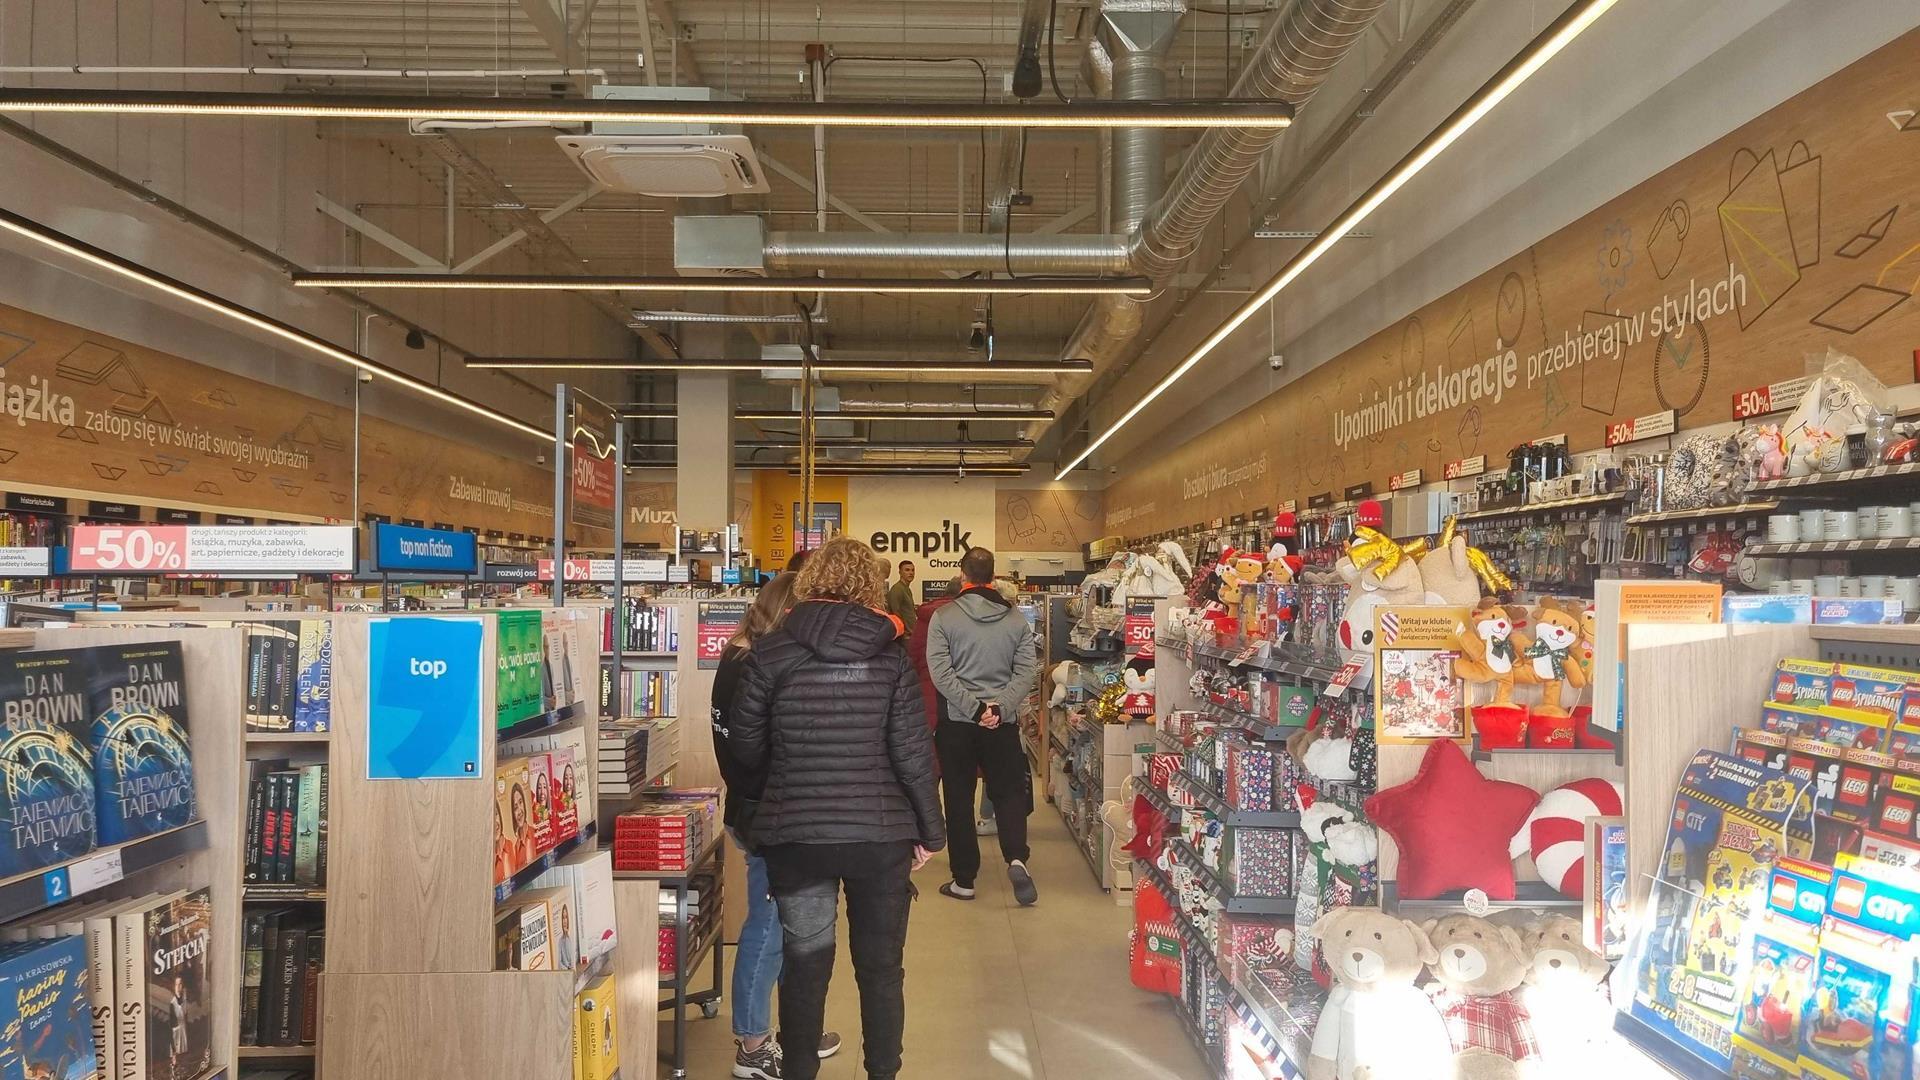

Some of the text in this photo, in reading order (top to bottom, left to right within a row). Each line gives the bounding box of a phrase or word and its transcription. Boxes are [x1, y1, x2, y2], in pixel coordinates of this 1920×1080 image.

[1527, 262, 1746, 389] przebieraj w stylach
[1334, 338, 1518, 452] Upominki i dekoracje
[1736, 391, 1770, 417] -50%
[84, 409, 131, 441] zatop
[134, 414, 156, 447] się
[159, 425, 172, 444] w
[174, 422, 211, 452] świat
[213, 435, 253, 464] swojej
[254, 444, 309, 470] wyobraźni
[1608, 423, 1633, 444] -50%
[574, 457, 596, 490] -50%
[449, 475, 482, 503] Zabawa
[486, 487, 511, 513] rozwój
[191, 538, 306, 548] książka, muzyka, zabawka,
[213, 528, 238, 537] tańszy
[238, 528, 268, 536] produkt
[870, 519, 972, 558] empik
[78, 528, 182, 570] -50%
[206, 548, 261, 558] papiernicze,
[261, 548, 296, 558] gadżety
[302, 548, 345, 558] dekoracje
[400, 537, 454, 559] top non fiction
[496, 568, 523, 579] rozwój
[1400, 617, 1421, 626] Witaj
[1429, 617, 1452, 625] klubie
[128, 662, 164, 684] DAN
[301, 631, 314, 703] PODZIELENI
[410, 657, 448, 679] top
[25, 672, 64, 697] DAN
[1777, 682, 1794, 693] LEGO
[111, 681, 180, 714] BROWN
[1832, 687, 1901, 712] LEGO SPIDERMAN
[5, 693, 84, 731] BROWN
[1746, 732, 1786, 746] WYDANIE
[1792, 739, 1841, 757] WYDANIE
[1710, 757, 1719, 769] 2
[1717, 759, 1763, 779] MAGAZYNY
[1847, 750, 1895, 767] WYDANIE
[116, 769, 189, 798] TAJEMNICA
[1842, 778, 1868, 796] LEGO
[9, 792, 92, 826] TAJEMNICA
[117, 785, 190, 819] TAJEMNIC
[1686, 811, 1707, 832] CITY
[1884, 806, 1911, 824] LEGO
[10, 810, 93, 849] TAJEMNIC
[51, 876, 63, 897] 2
[1866, 894, 1914, 925] CITY
[154, 931, 211, 975] STEFCIA
[25, 954, 73, 979] KRASOWSKA
[284, 955, 294, 985] TOLKIEN
[18, 991, 61, 1023] Paris
[123, 1001, 142, 1080] STEFCIA
